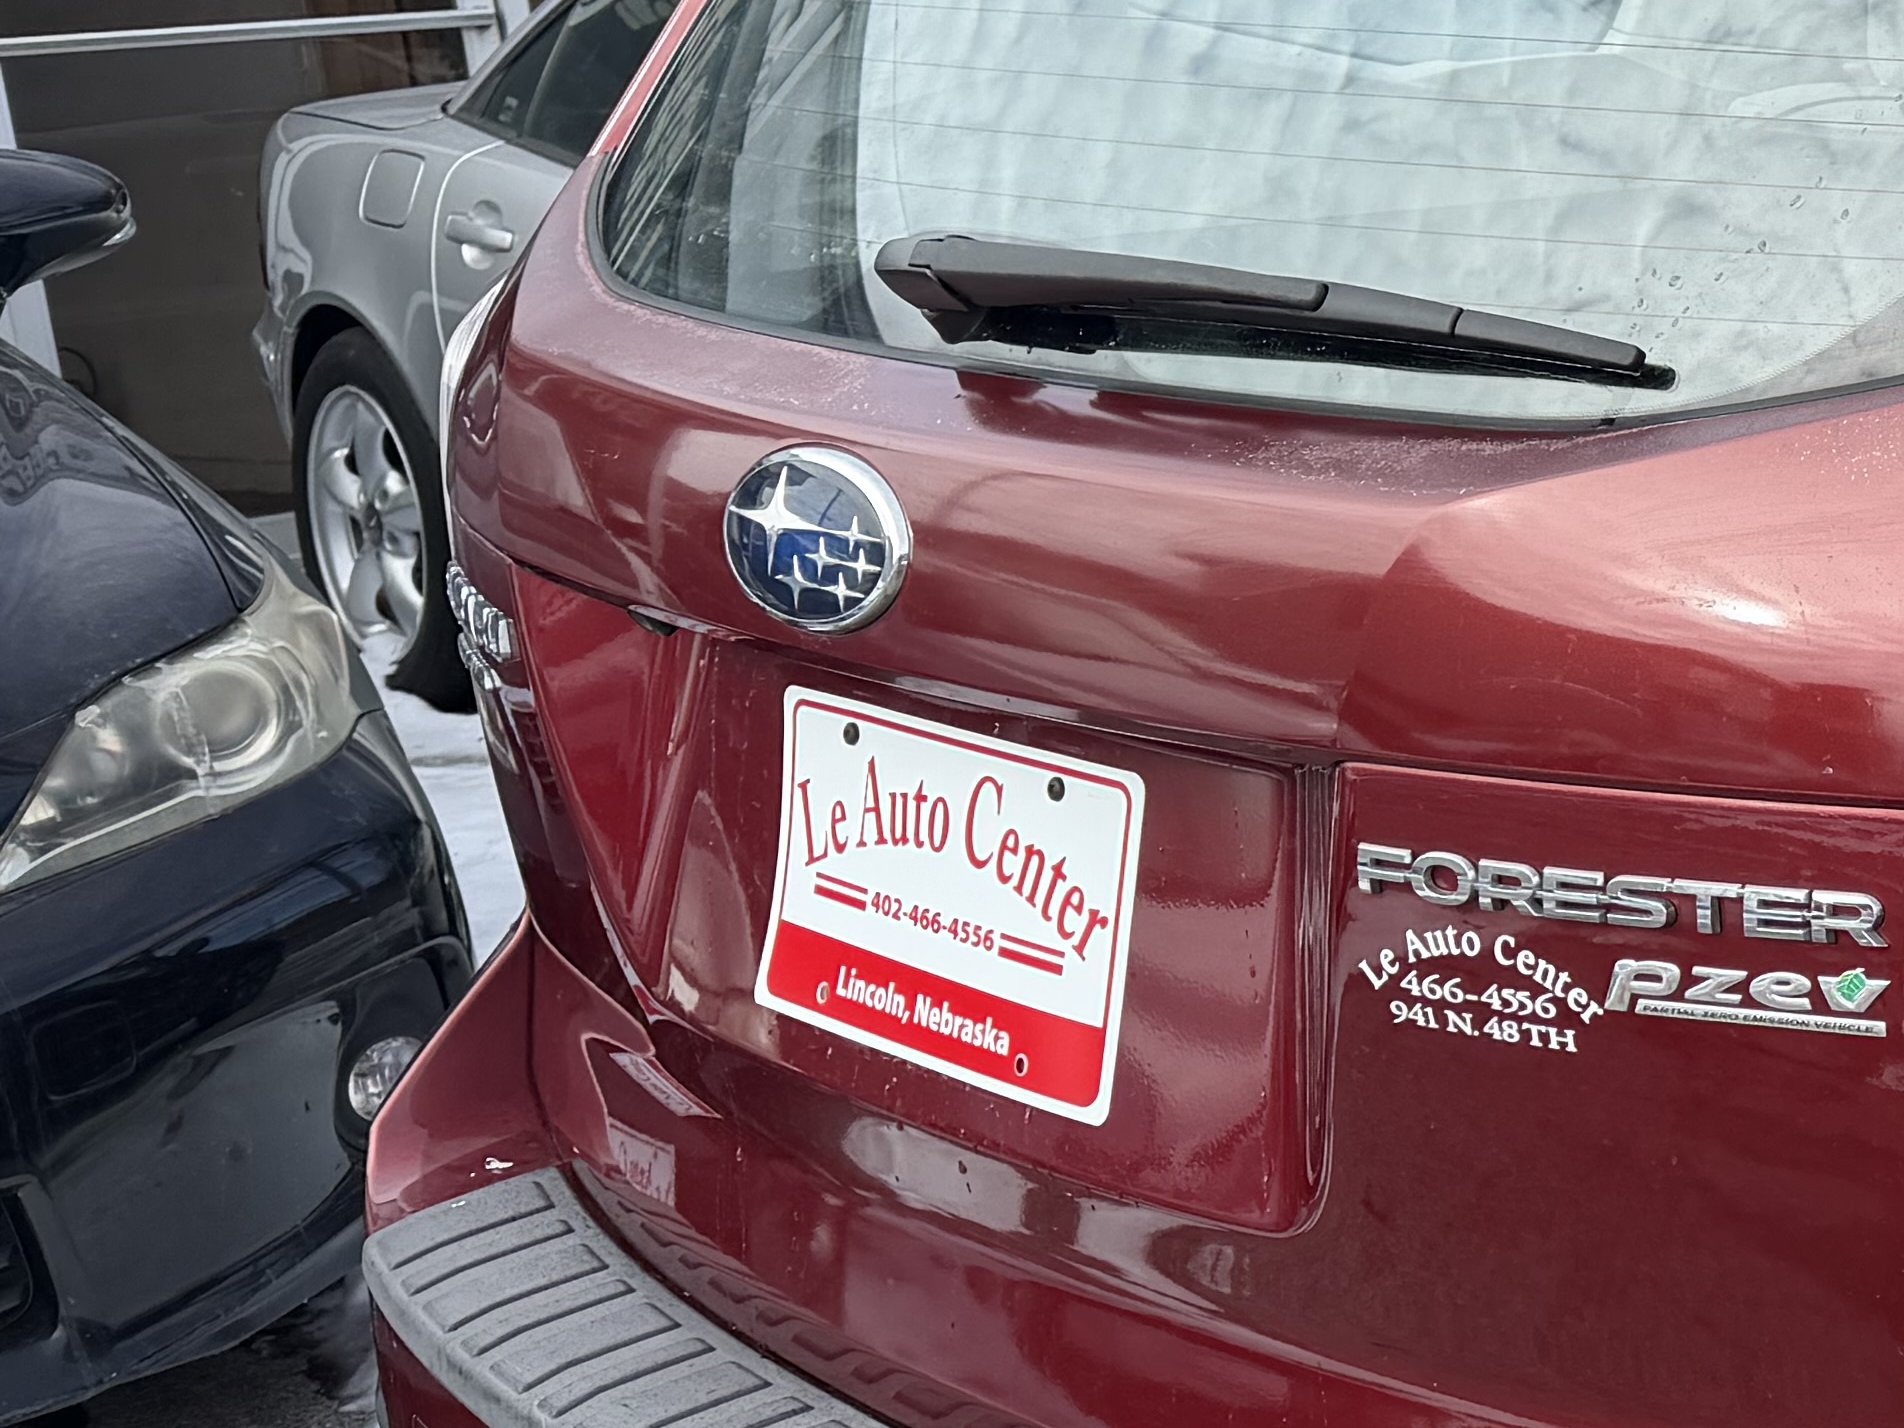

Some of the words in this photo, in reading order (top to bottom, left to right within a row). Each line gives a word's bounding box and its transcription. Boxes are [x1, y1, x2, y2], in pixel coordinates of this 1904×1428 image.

[797, 777, 849, 867] Le
[856, 755, 950, 853] Auto
[964, 775, 1109, 962] Center
[1356, 841, 1890, 949] FORESTER
[870, 891, 995, 952] 402-466-4556
[835, 964, 911, 1026] Lincoln,
[912, 992, 1011, 1057] Nebraska
[1358, 947, 1400, 991] Le
[1405, 924, 1481, 964] Auto
[1493, 934, 1605, 1025] Center
[1399, 970, 1557, 1019] 466-4556
[1389, 1000, 1439, 1030] 941
[1443, 1009, 1480, 1037] N.
[1642, 1003, 1695, 1017] PARTIAL
[1699, 1010, 1739, 1023] ZERO
[1741, 1013, 1811, 1030] EMISSION
[1814, 1020, 1875, 1034] VEHICLE
